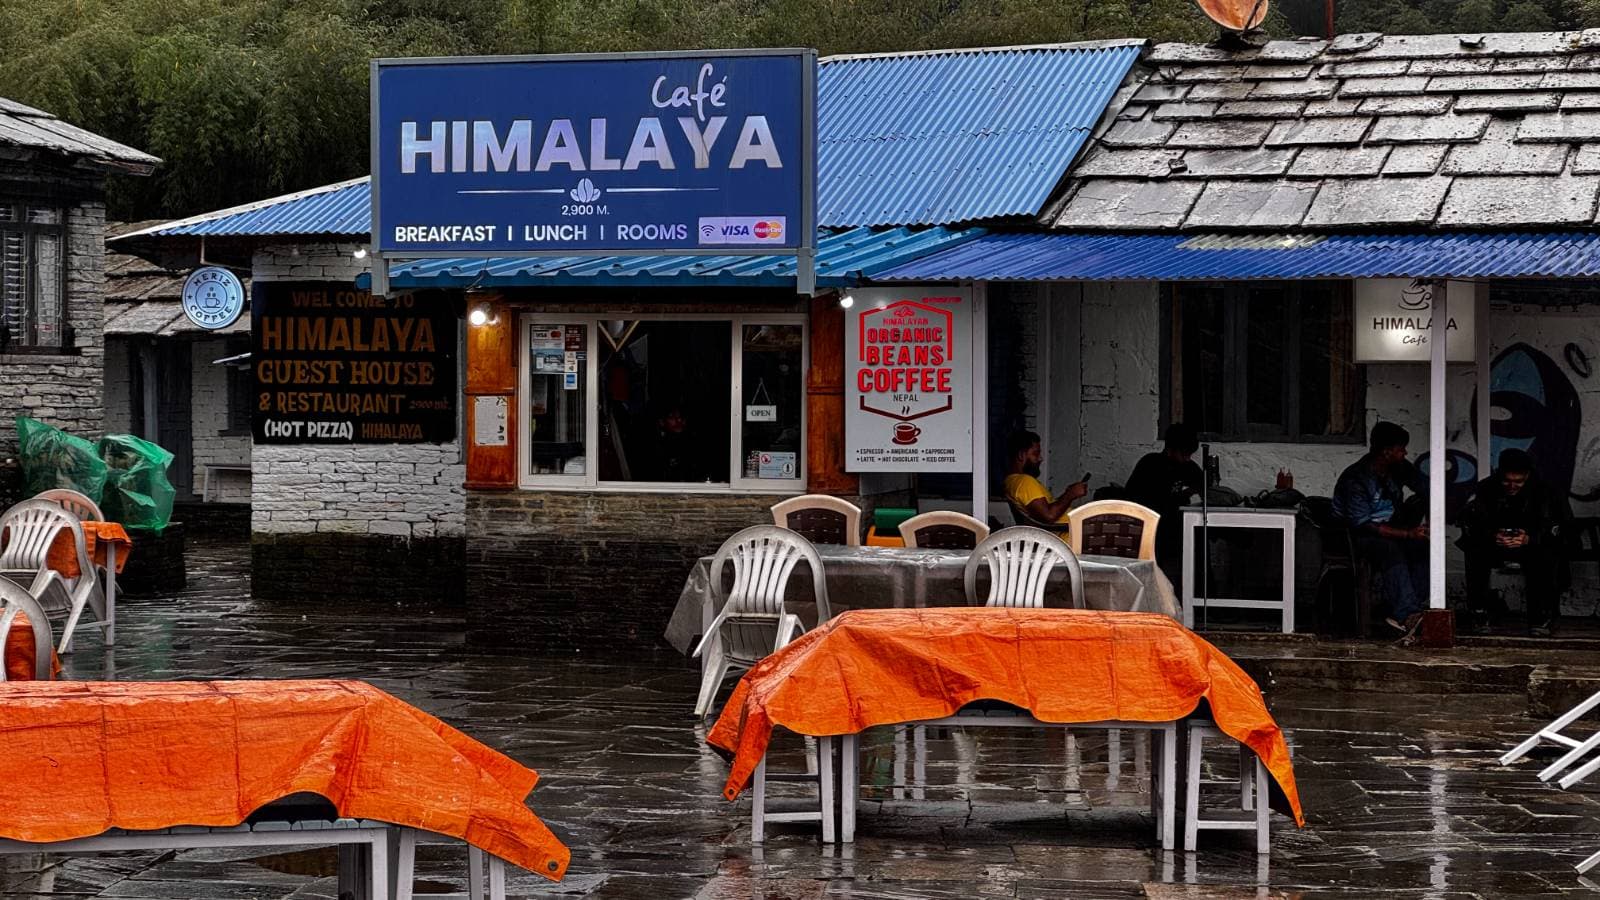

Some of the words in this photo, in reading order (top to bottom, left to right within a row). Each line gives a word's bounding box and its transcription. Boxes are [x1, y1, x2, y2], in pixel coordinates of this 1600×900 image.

[651, 62, 728, 122] Café
[401, 115, 783, 173] HIMALAYA
[561, 204, 594, 217] 2,900
[395, 225, 497, 242] BREAKFAST
[525, 224, 587, 241] LUNCH
[617, 223, 688, 241] ROOMS
[721, 225, 750, 236] VISA
[190, 305, 232, 323] COFFEE
[1373, 317, 1458, 330] HIMALAA
[261, 316, 435, 352] HIMALAYA
[867, 327, 943, 343] ORGANIC
[1402, 335, 1427, 346] Cafe
[866, 345, 944, 366] BEANS
[257, 360, 344, 384] GUEST
[349, 361, 434, 385] HOUSE
[857, 367, 952, 392] COFFEE
[259, 392, 271, 411] &
[277, 391, 406, 415] RESTAURANT
[893, 394, 918, 402] NEPAL
[264, 419, 304, 438] (HOT
[307, 420, 354, 440] PIZZA)
[361, 423, 423, 439] HIMALAYA
